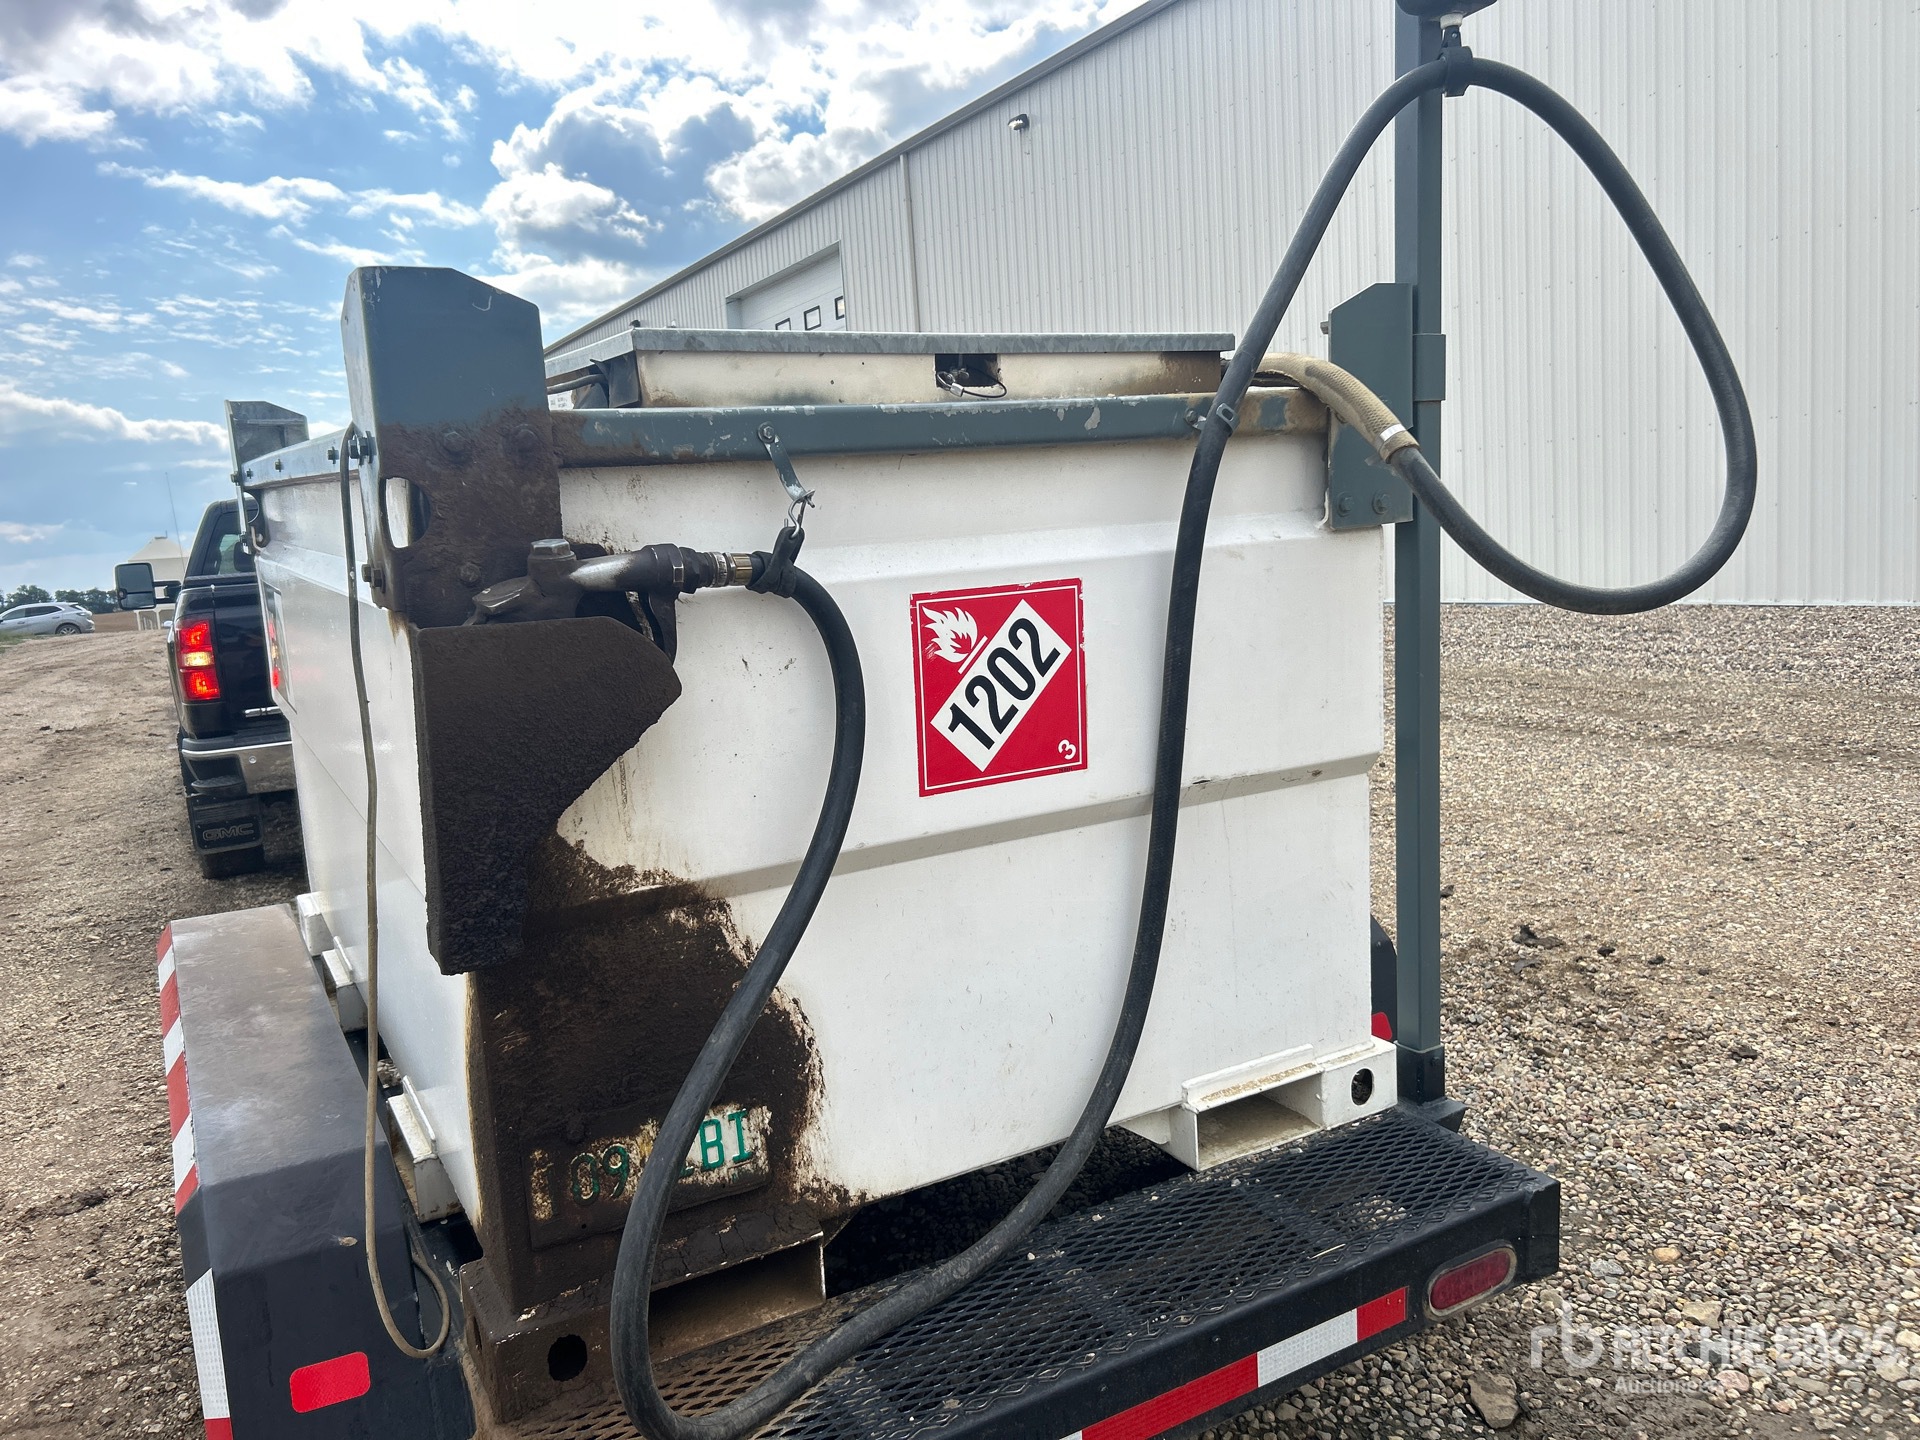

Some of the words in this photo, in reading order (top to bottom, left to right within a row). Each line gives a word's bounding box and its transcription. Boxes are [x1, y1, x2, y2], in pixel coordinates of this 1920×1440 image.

[948, 618, 1060, 750] 1202
[1058, 739, 1077, 760] 3
[203, 823, 254, 841] GMC
[678, 1108, 753, 1178] BI
